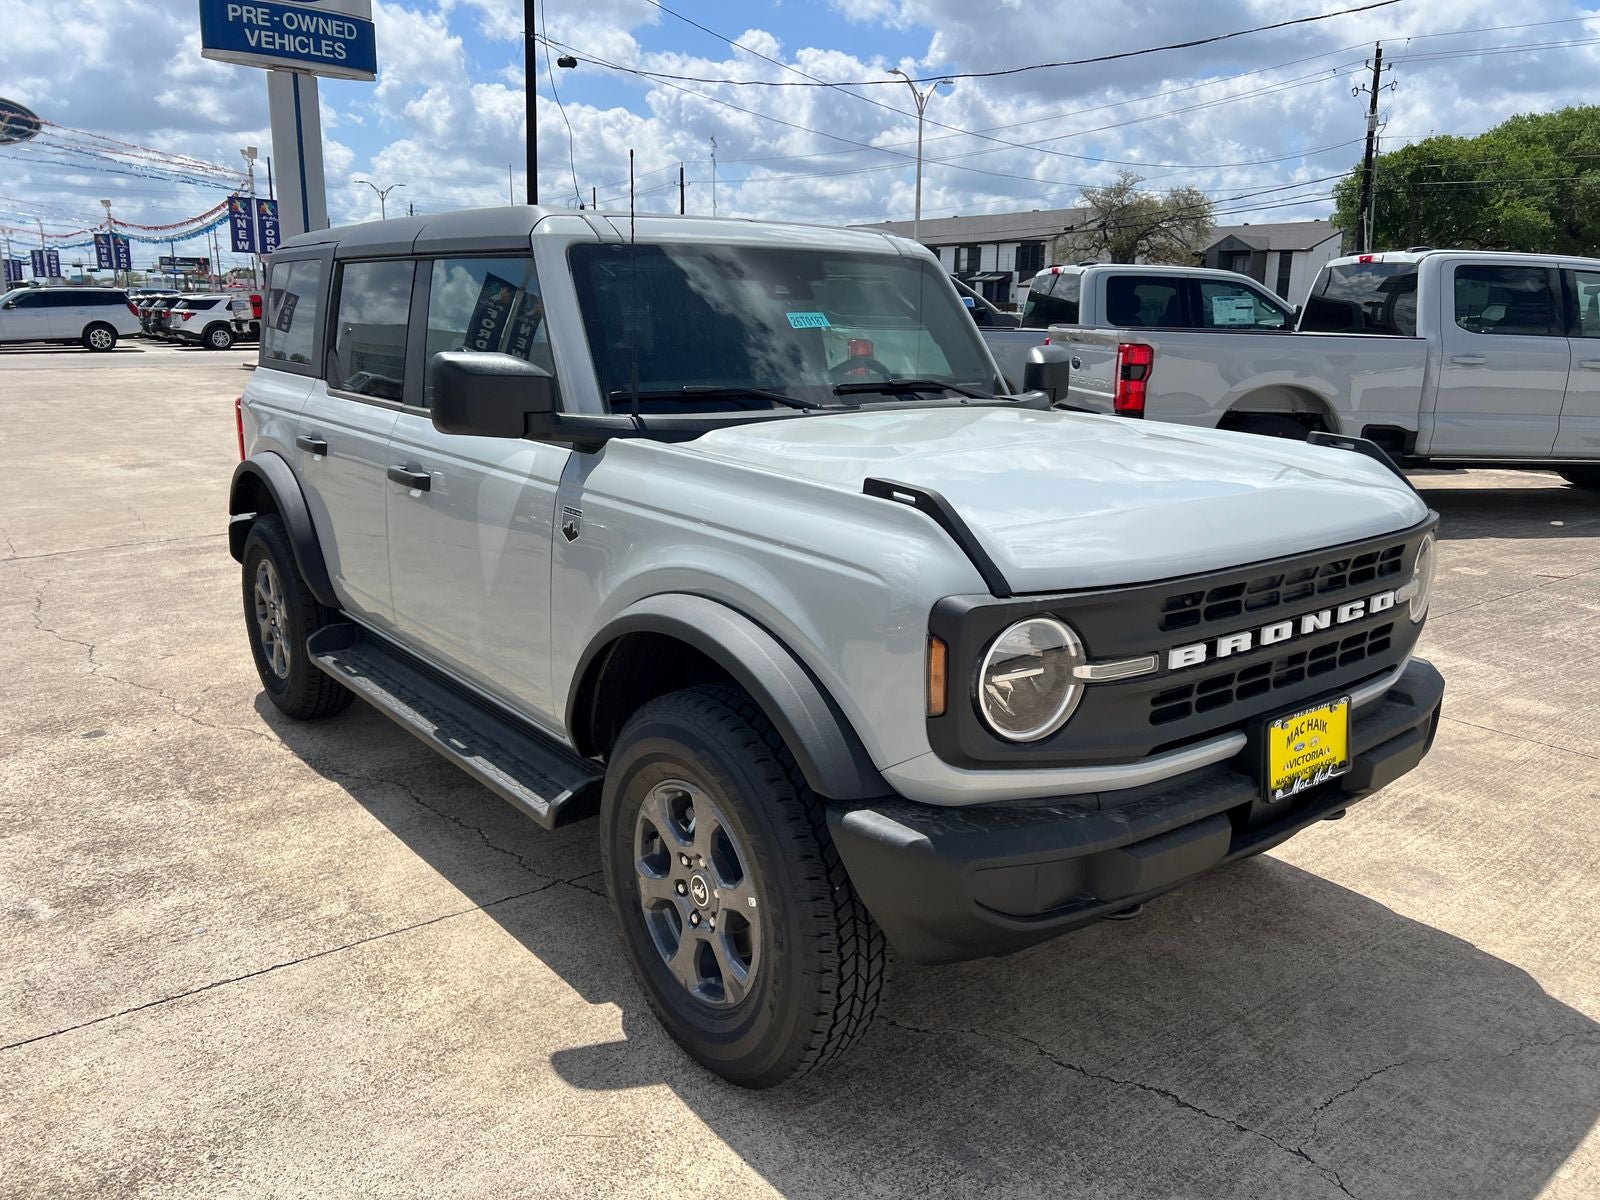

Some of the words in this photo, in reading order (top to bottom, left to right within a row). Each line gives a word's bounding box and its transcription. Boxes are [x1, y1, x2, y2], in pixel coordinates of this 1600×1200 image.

[244, 28, 347, 60] VEHICLES
[236, 218, 250, 250] NEW
[265, 220, 276, 252] FORD
[100, 247, 109, 267] NEW
[119, 247, 128, 268] FORD
[1168, 591, 1394, 669] BRONCO
[1286, 721, 1305, 749] MAC
[1307, 718, 1328, 734] HAIK
[1289, 747, 1324, 769] VICTORIA
[1292, 776, 1311, 794] Mac
